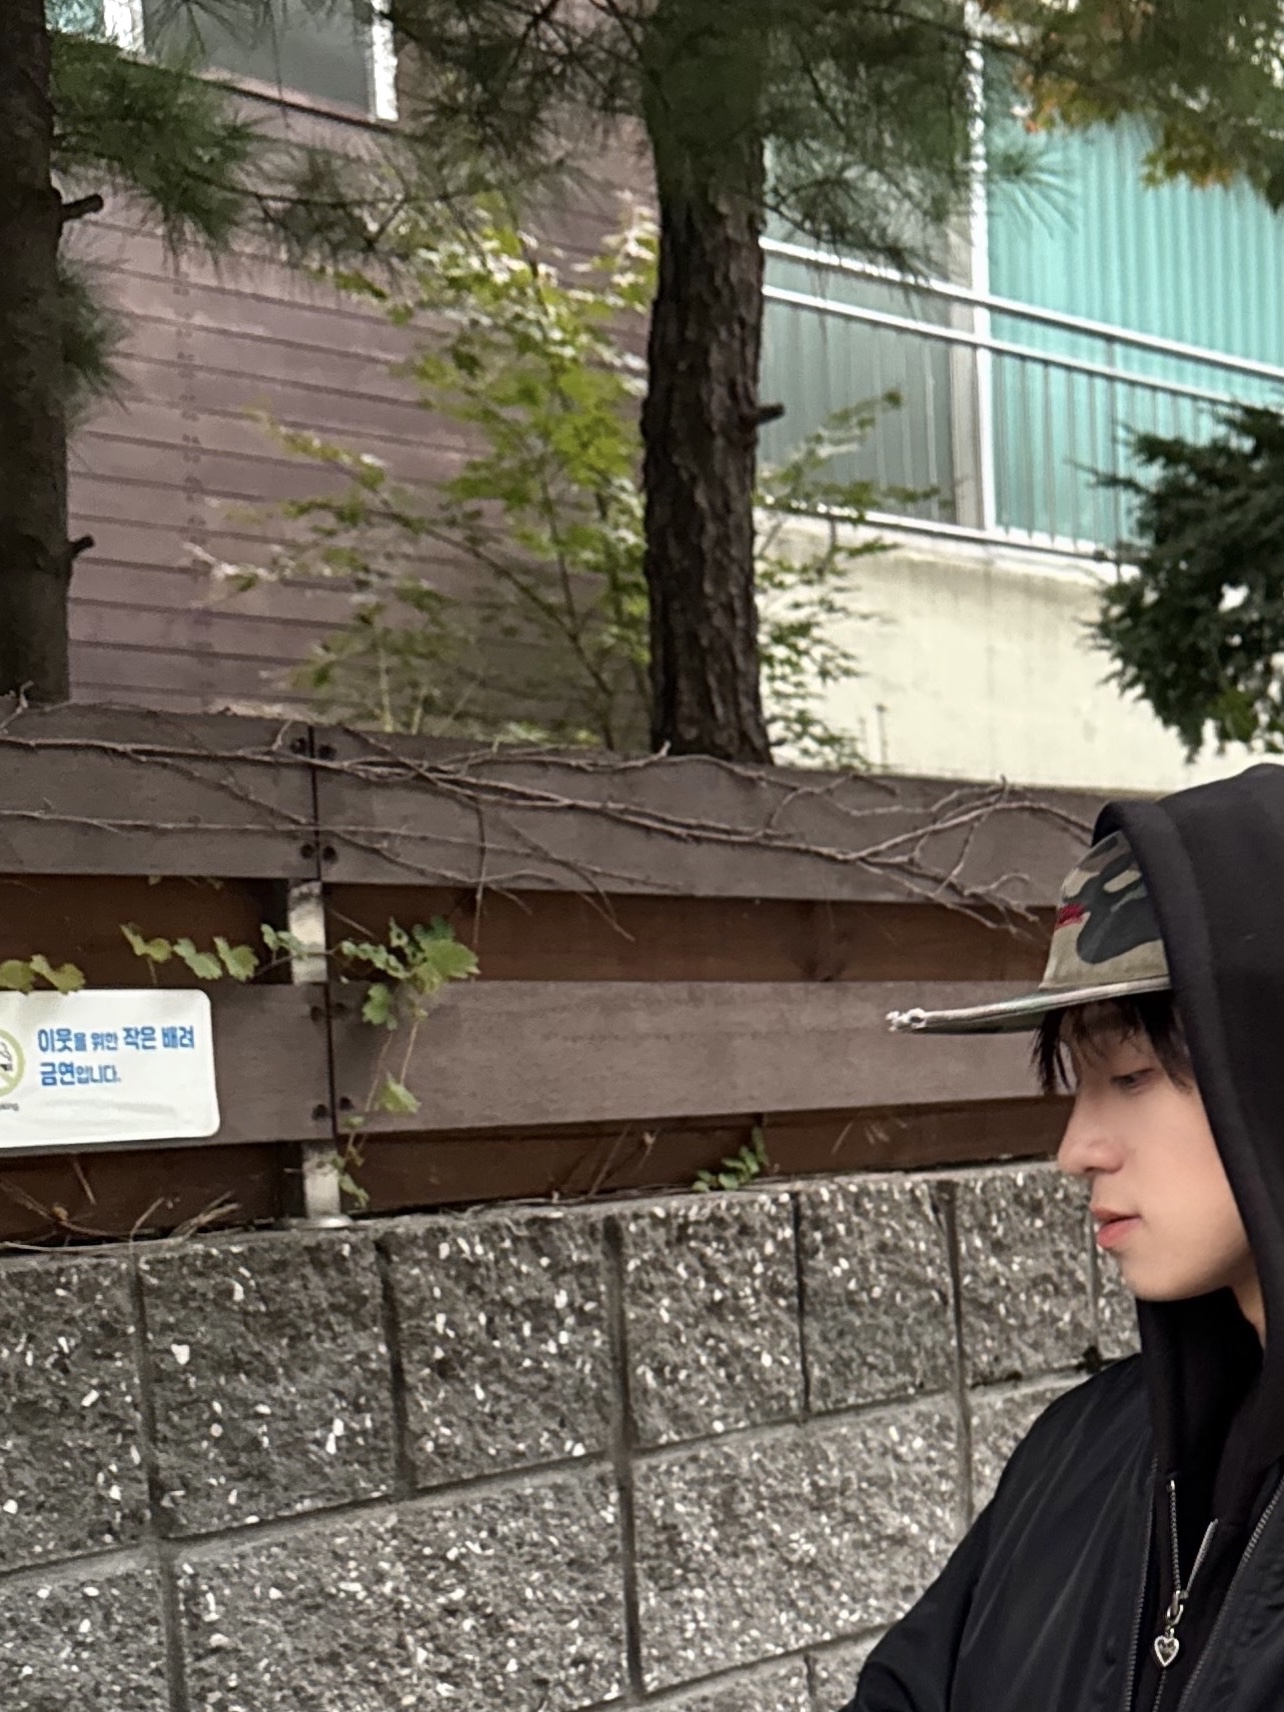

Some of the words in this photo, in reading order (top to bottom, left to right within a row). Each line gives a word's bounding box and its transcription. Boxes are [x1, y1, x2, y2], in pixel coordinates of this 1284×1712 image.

[91, 1032, 118, 1051] 위한
[122, 1026, 157, 1050] 작은
[161, 1025, 195, 1049] 배려
[40, 1062, 121, 1086] 금연입니다.
